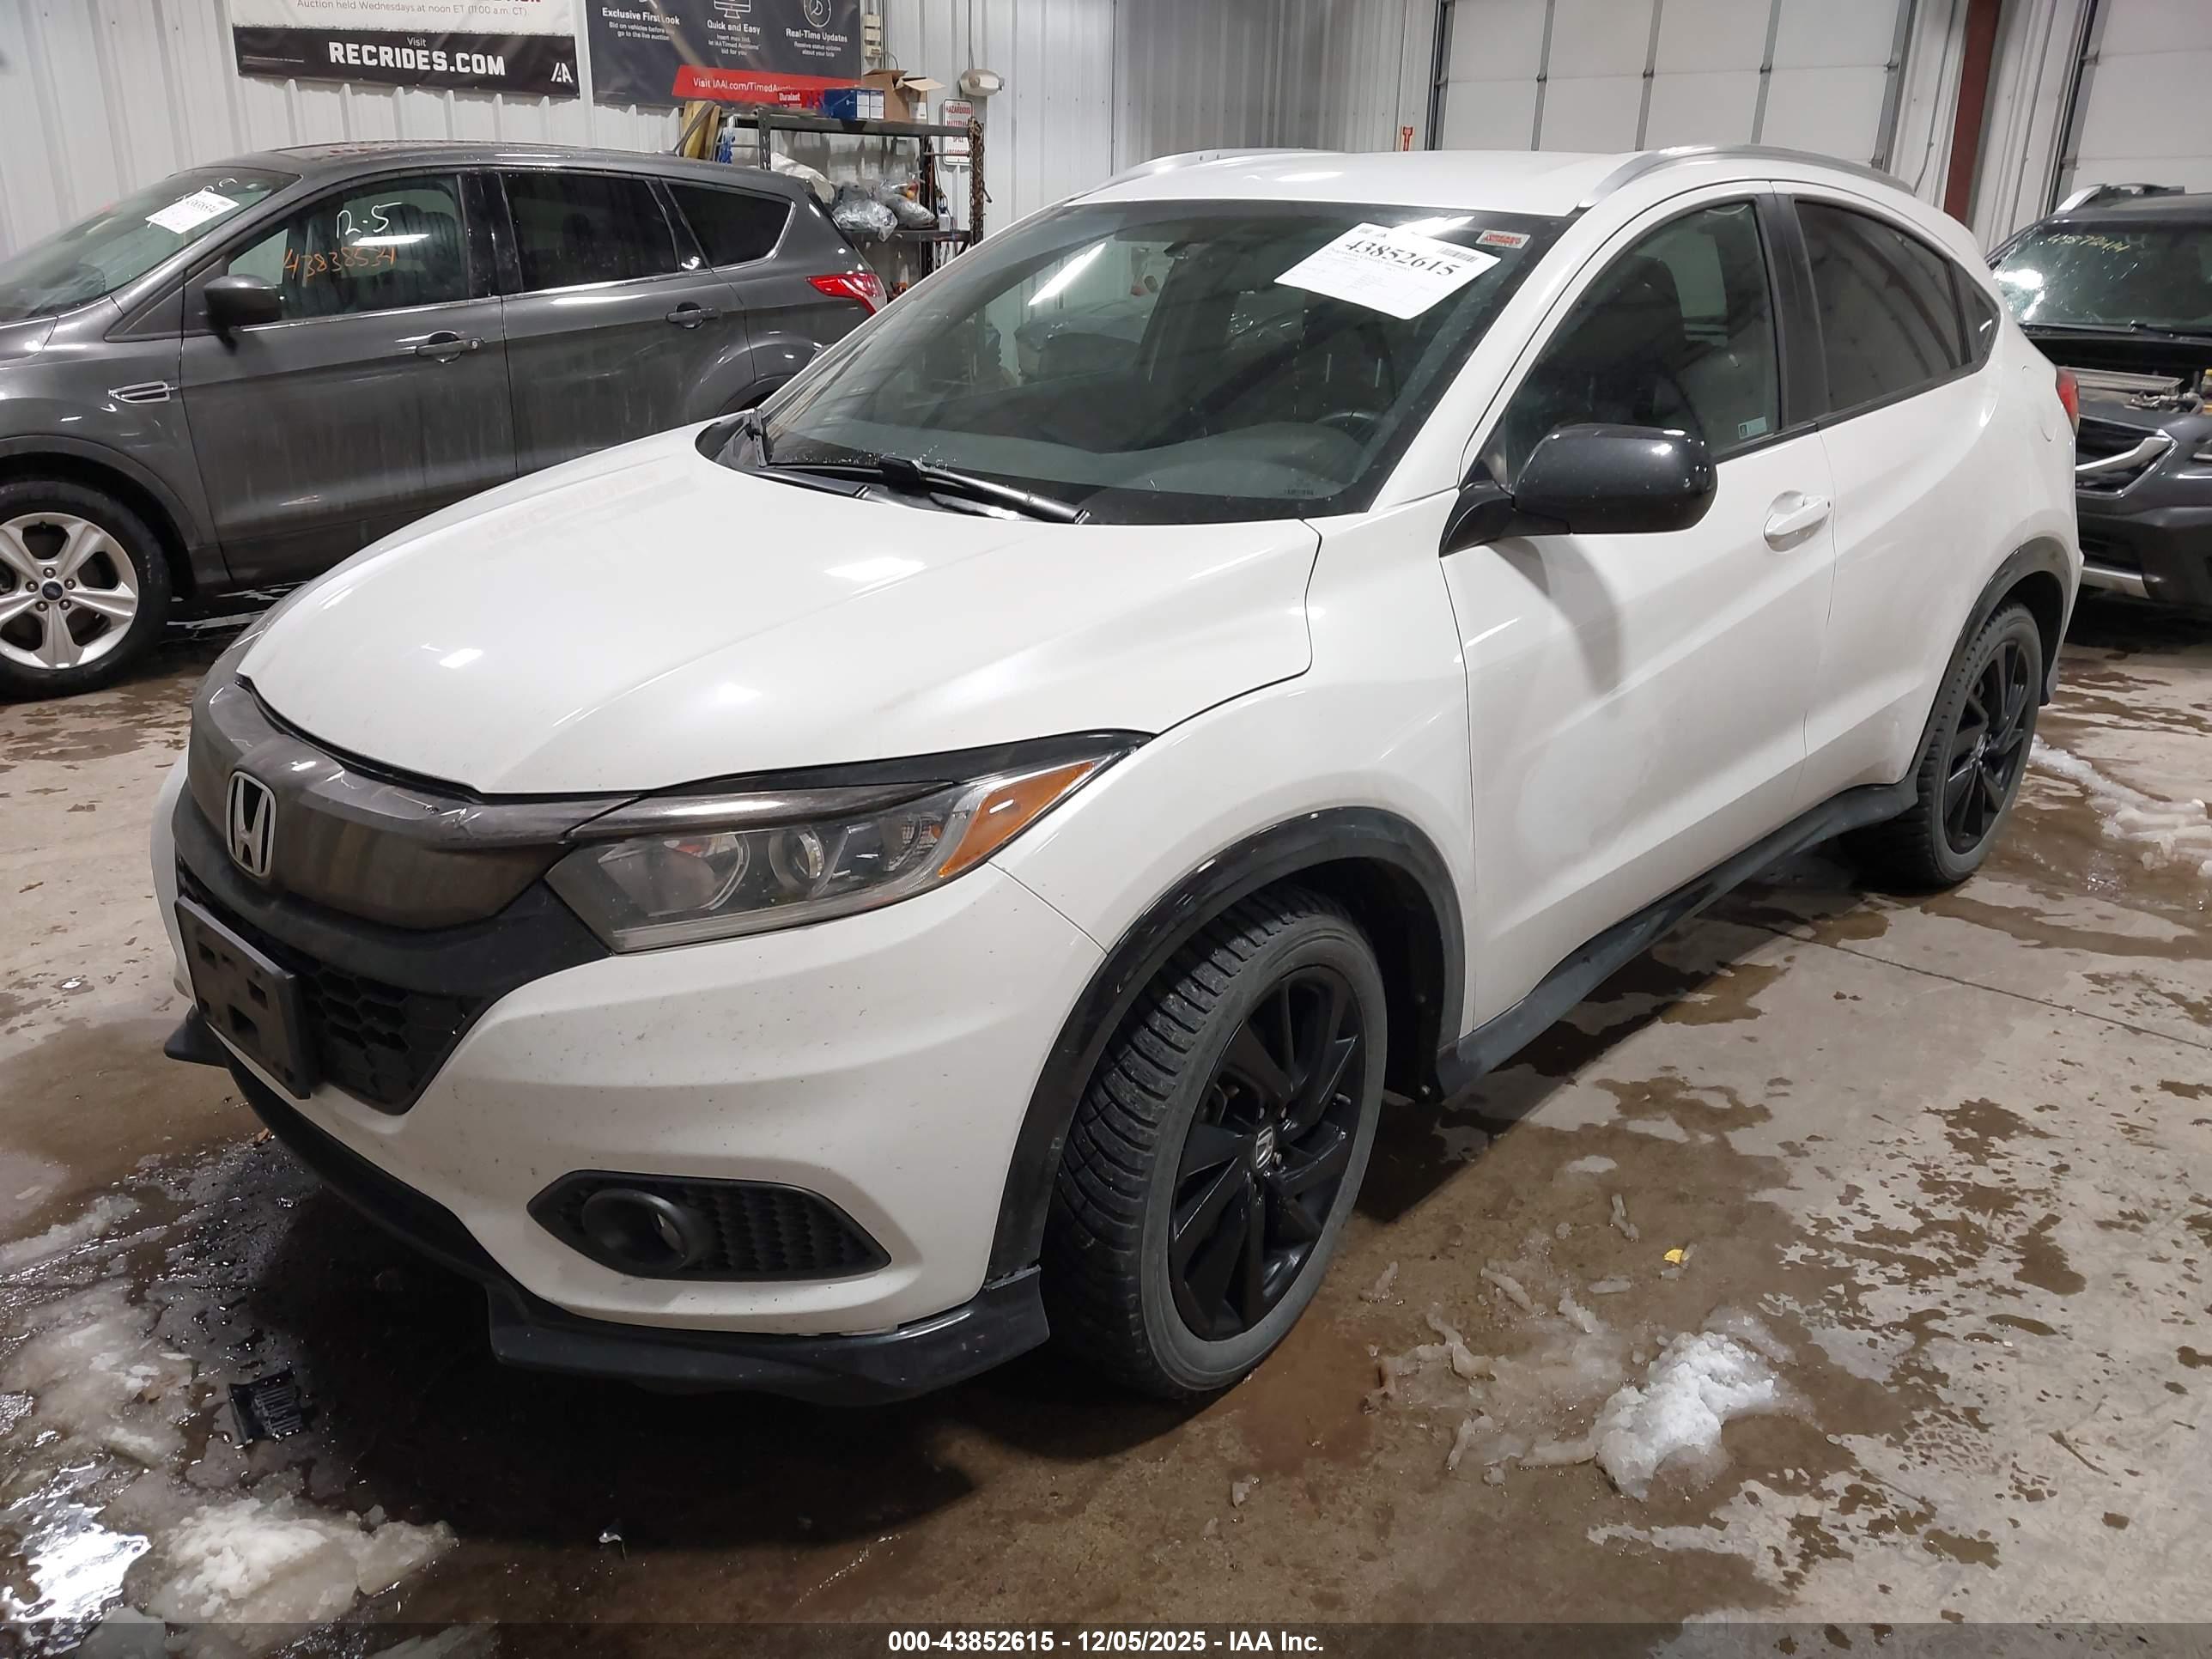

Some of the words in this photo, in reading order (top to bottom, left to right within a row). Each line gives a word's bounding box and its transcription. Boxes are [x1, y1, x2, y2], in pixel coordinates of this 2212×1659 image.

[336, 0, 356, 9] held
[360, 2, 416, 13] Wednesdays
[416, 4, 426, 13] at
[453, 4, 465, 14] ET
[602, 7, 641, 21] Exclusive
[642, 11, 660, 22] First
[707, 19, 726, 31] Quick
[727, 23, 742, 33] and
[743, 23, 762, 35] Easy
[406, 36, 427, 47] Visit
[785, 27, 822, 40] Real-Time
[822, 33, 848, 43] Updates
[328, 41, 506, 76] RECRIDES.COM
[693, 77, 711, 88] Visit
[778, 91, 800, 102] Duralast
[1345, 240, 1462, 276] 43852615
